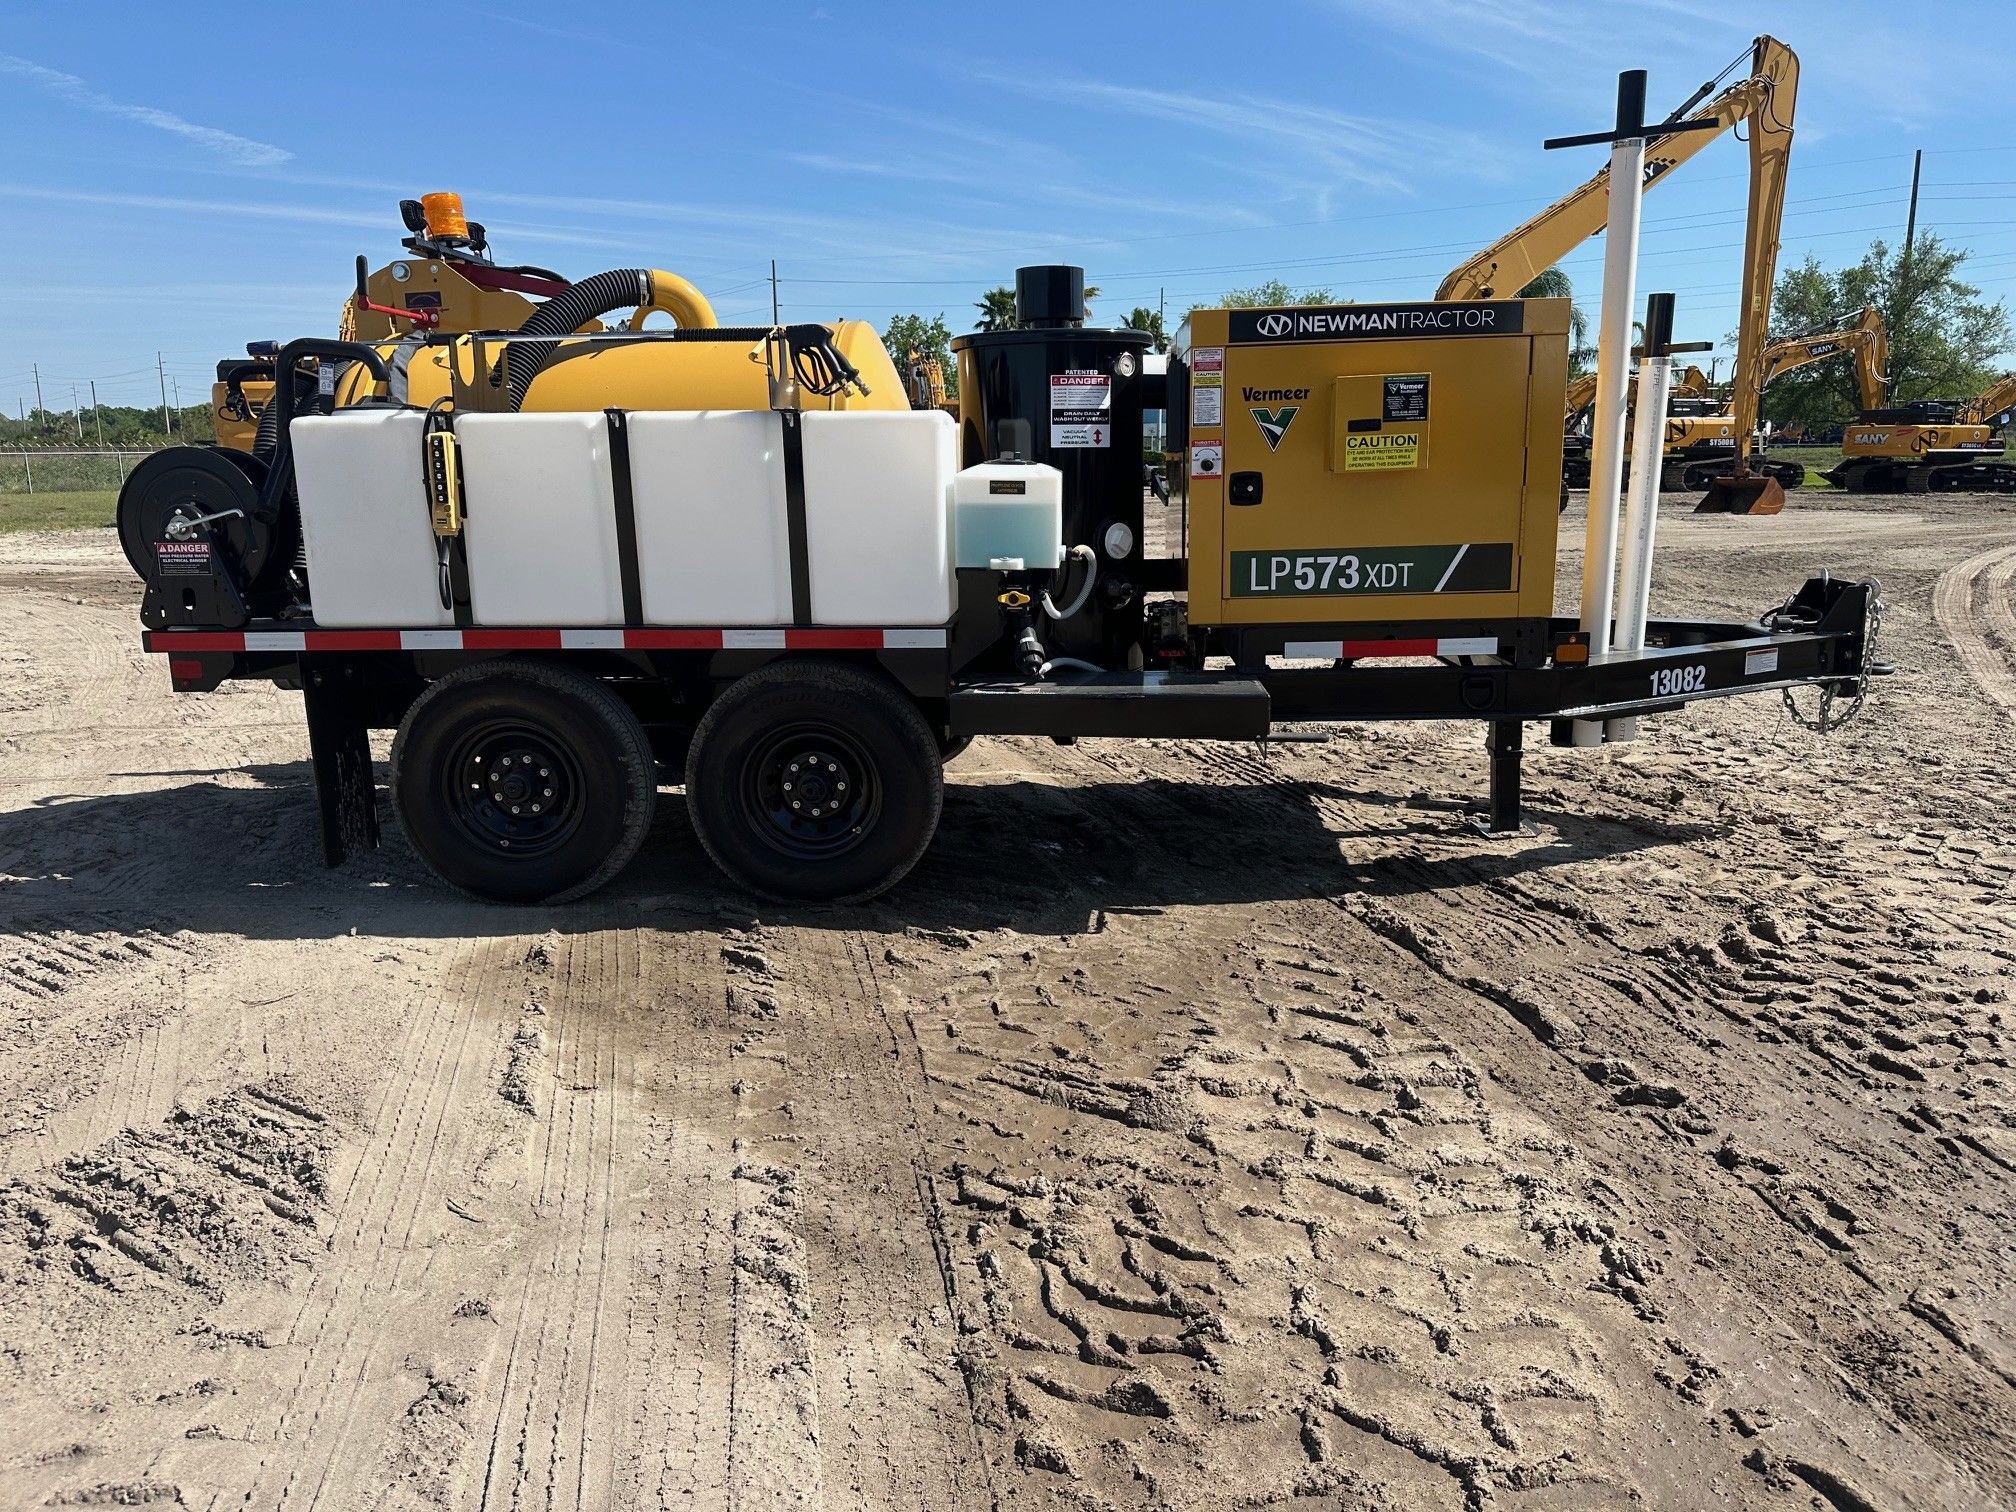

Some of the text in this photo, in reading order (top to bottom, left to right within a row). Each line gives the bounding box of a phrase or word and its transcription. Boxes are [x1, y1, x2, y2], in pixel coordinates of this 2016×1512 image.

[1299, 309, 1496, 333] NEWMANTRACTOR
[1811, 344, 1834, 355] SANY
[1060, 377, 1105, 385] DANGER
[1241, 386, 1311, 402] Vermeer
[1346, 434, 1418, 449] CAUTION
[1854, 433, 1890, 446] SANY
[167, 544, 209, 553] DANGER
[1650, 664, 1706, 696] 13082
